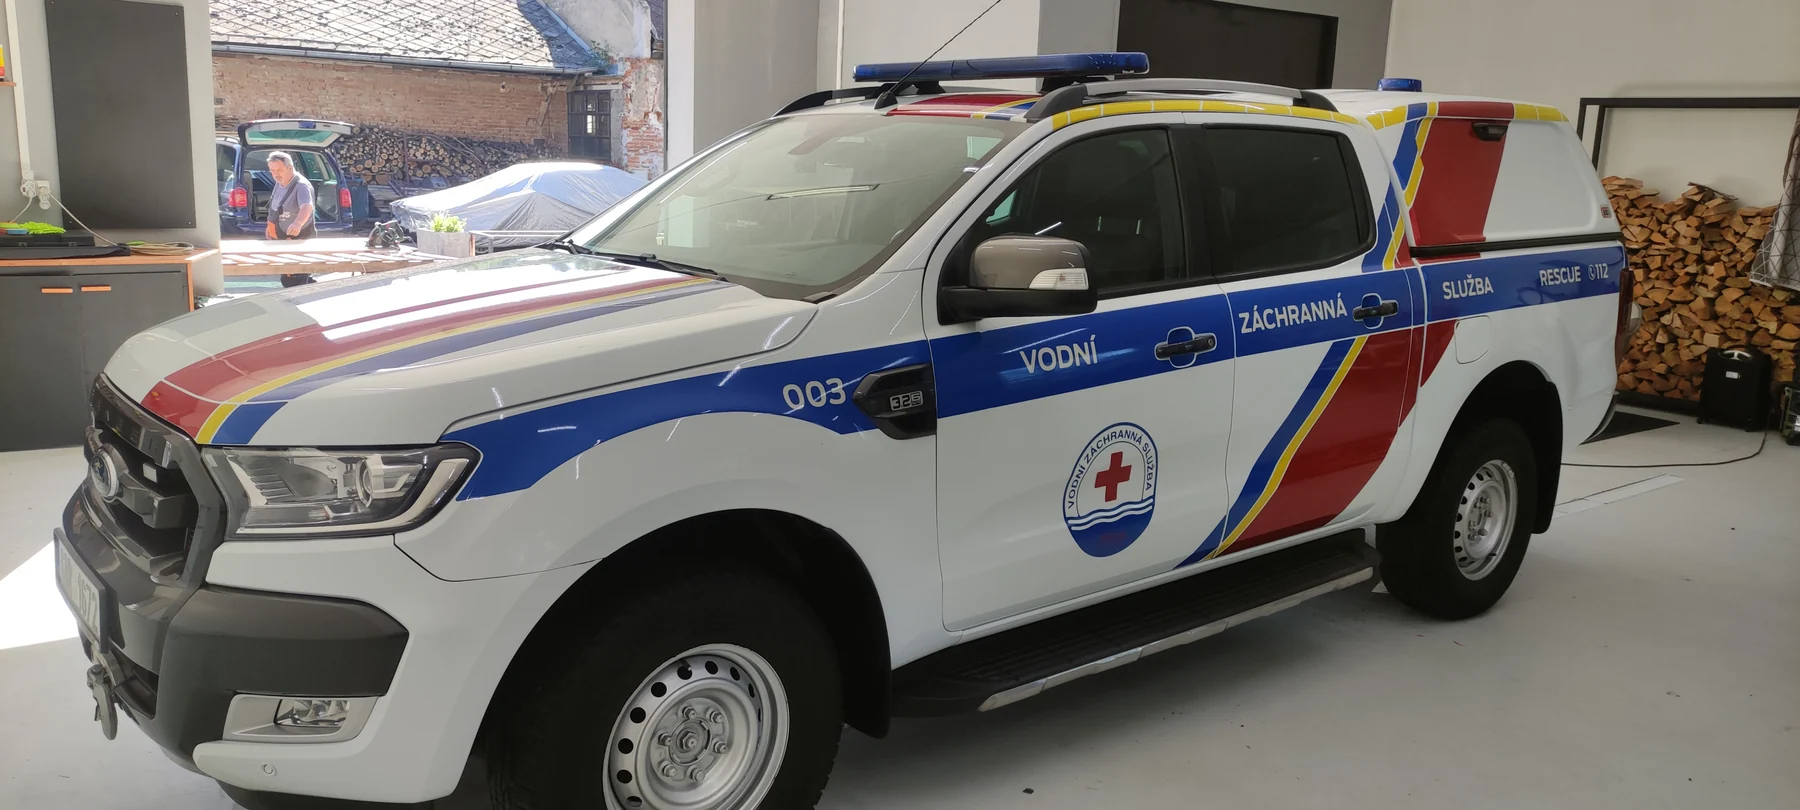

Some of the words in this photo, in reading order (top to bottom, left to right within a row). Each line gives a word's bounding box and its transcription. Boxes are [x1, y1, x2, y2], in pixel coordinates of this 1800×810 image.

[1539, 266, 1581, 286] RESCUE
[1020, 335, 1098, 374] VODNÍ
[1239, 293, 1347, 334] ZÁCHRANNÁ
[1442, 273, 1494, 300] SLUŽBA
[782, 378, 847, 410] 003
[1068, 464, 1086, 509] VODNÍ
[1084, 429, 1143, 464] ZÁCHRANNÁ
[1142, 442, 1154, 491] SLUŽBA
